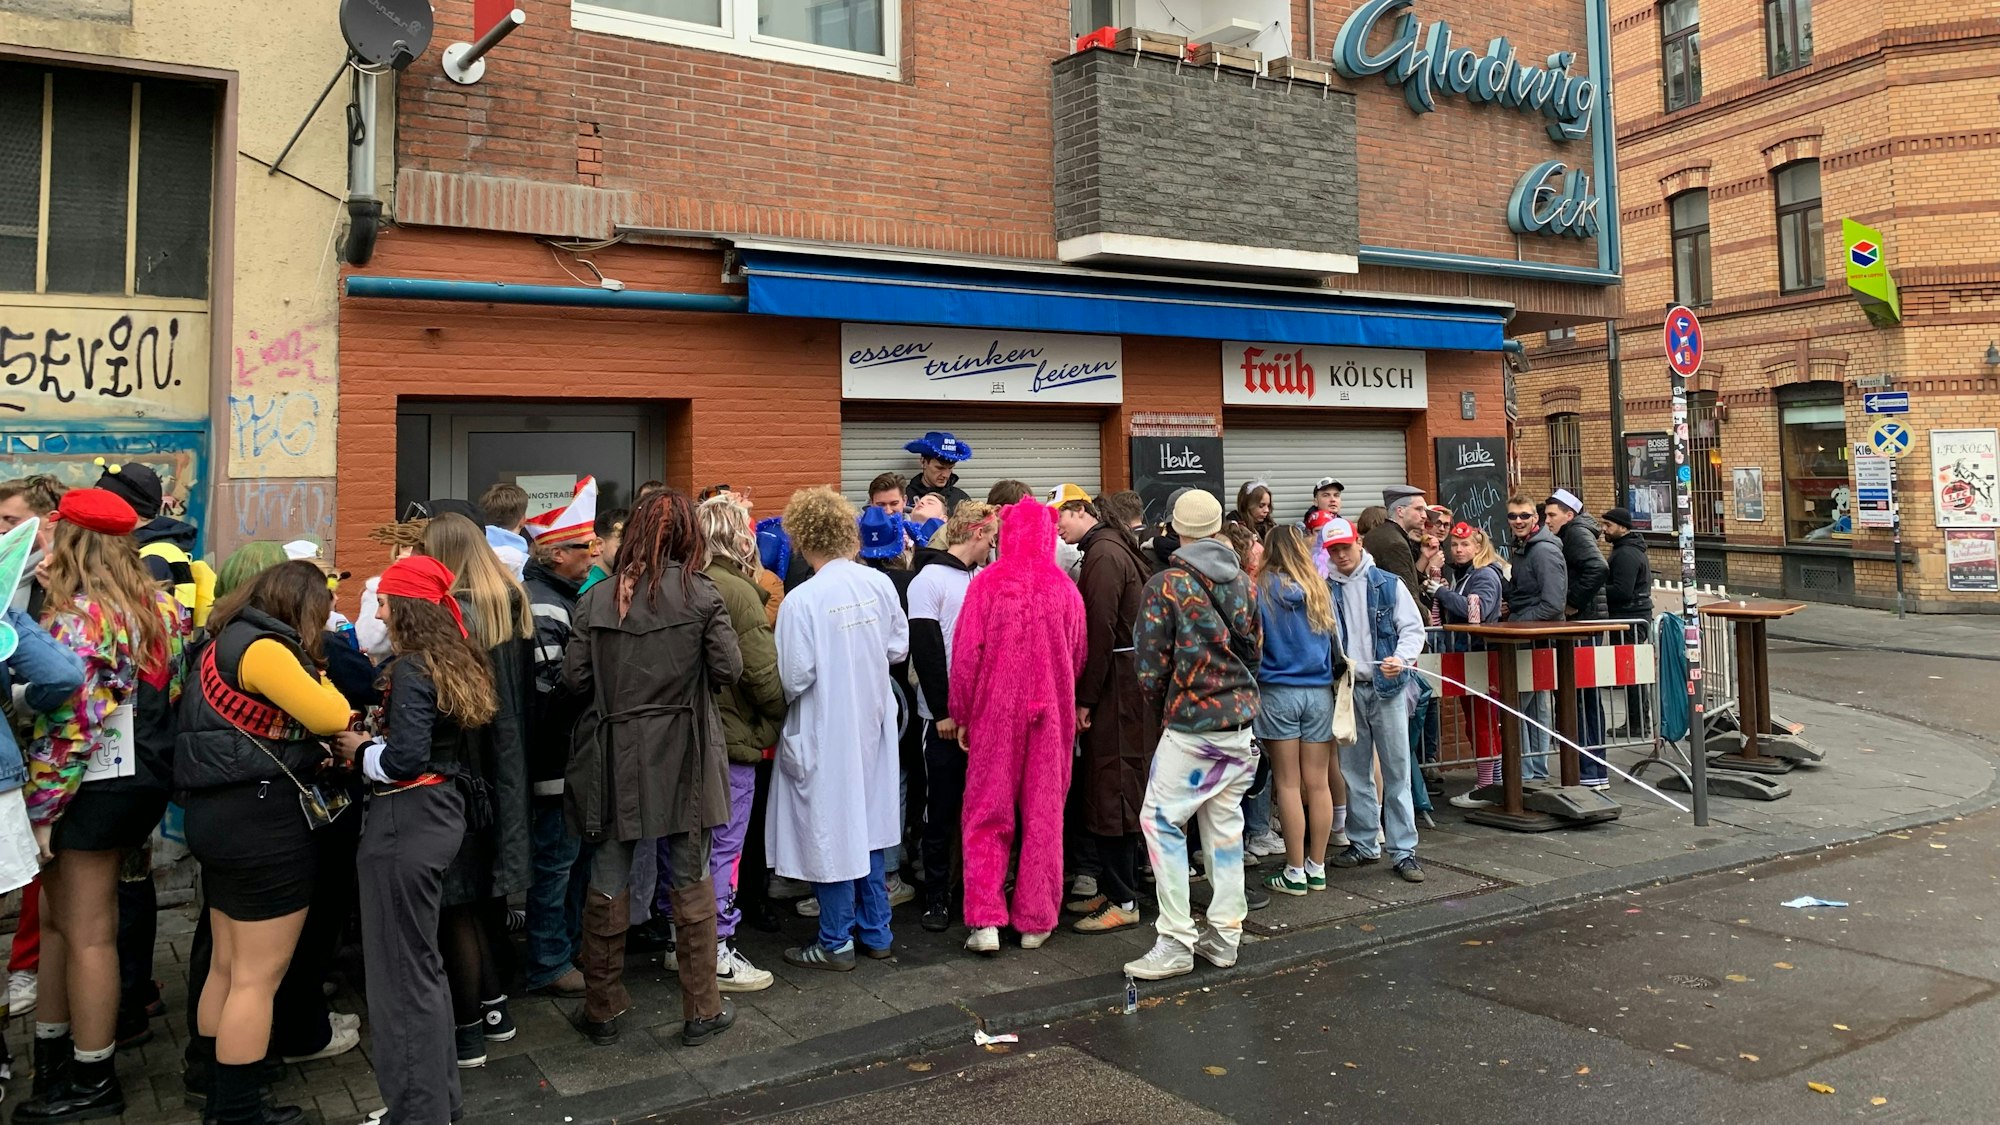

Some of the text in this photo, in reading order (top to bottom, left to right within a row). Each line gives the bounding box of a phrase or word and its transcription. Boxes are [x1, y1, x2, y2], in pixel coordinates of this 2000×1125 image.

[1507, 160, 1600, 239] Eck
[849, 342, 933, 364] essen
[924, 340, 1043, 376] trinken
[1032, 359, 1117, 392] feiern
[1329, 361, 1413, 390] KÖLSCH
[1160, 443, 1202, 468] Heute
[1458, 442, 1494, 466] Heute
[1648, 439, 1669, 447] BOSSE
[1855, 445, 1876, 455] KIO
